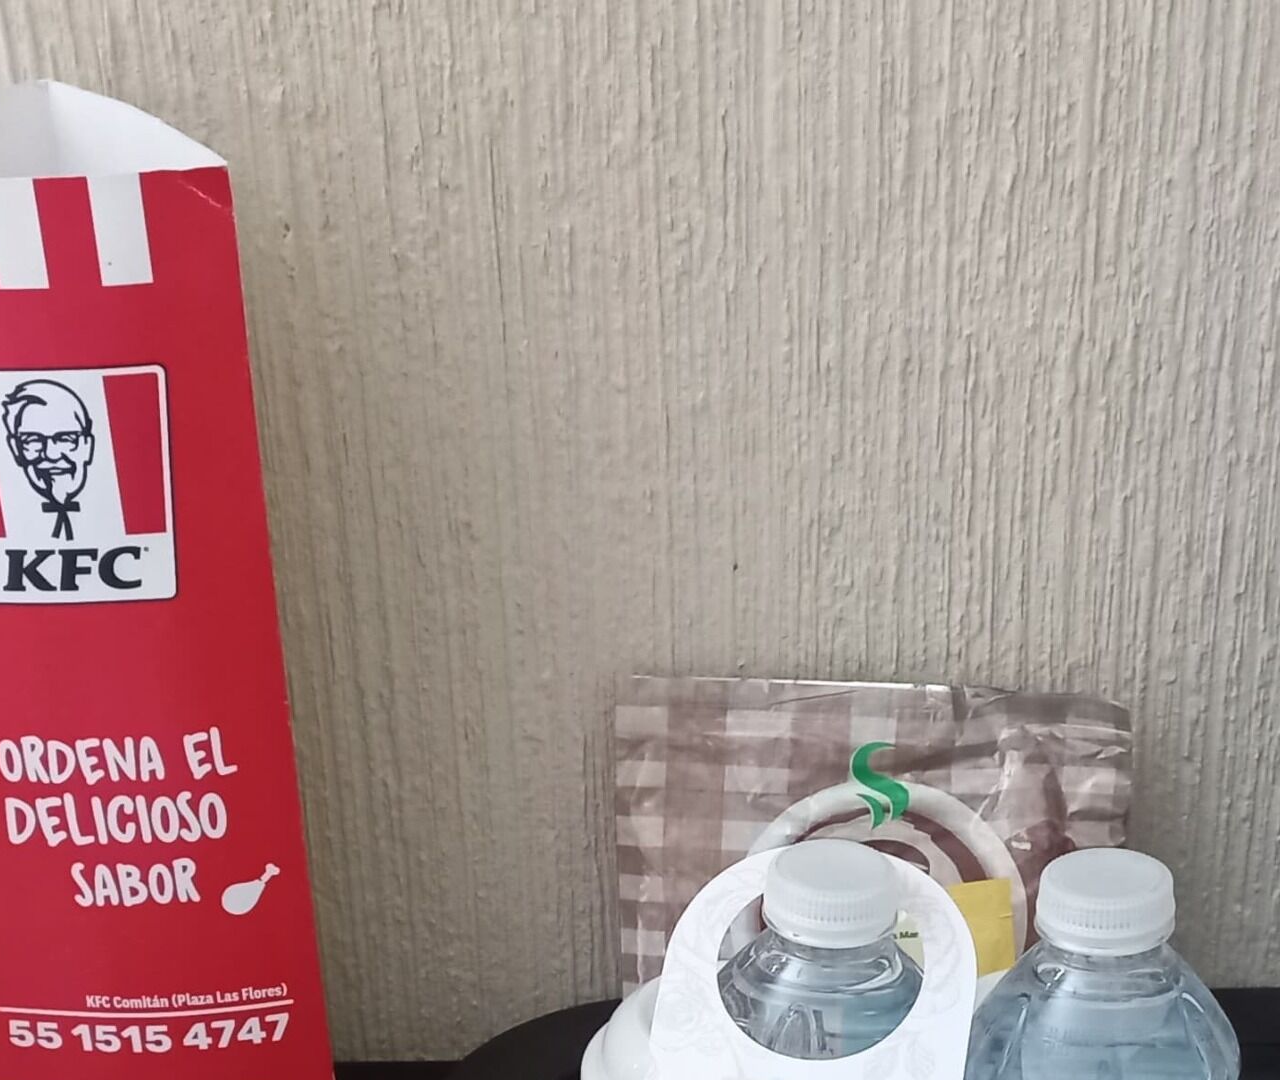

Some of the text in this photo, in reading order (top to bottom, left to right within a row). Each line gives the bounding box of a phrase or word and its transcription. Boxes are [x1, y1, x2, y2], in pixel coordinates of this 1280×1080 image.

[3, 546, 143, 592] KFC
[183, 726, 238, 780] EL
[4, 791, 228, 847] DELICIOSO
[70, 857, 201, 907] SABOR
[85, 983, 288, 1009] KFC Comitán (Plaza Las Flores)
[8, 1012, 290, 1053] 55 1515 4747
